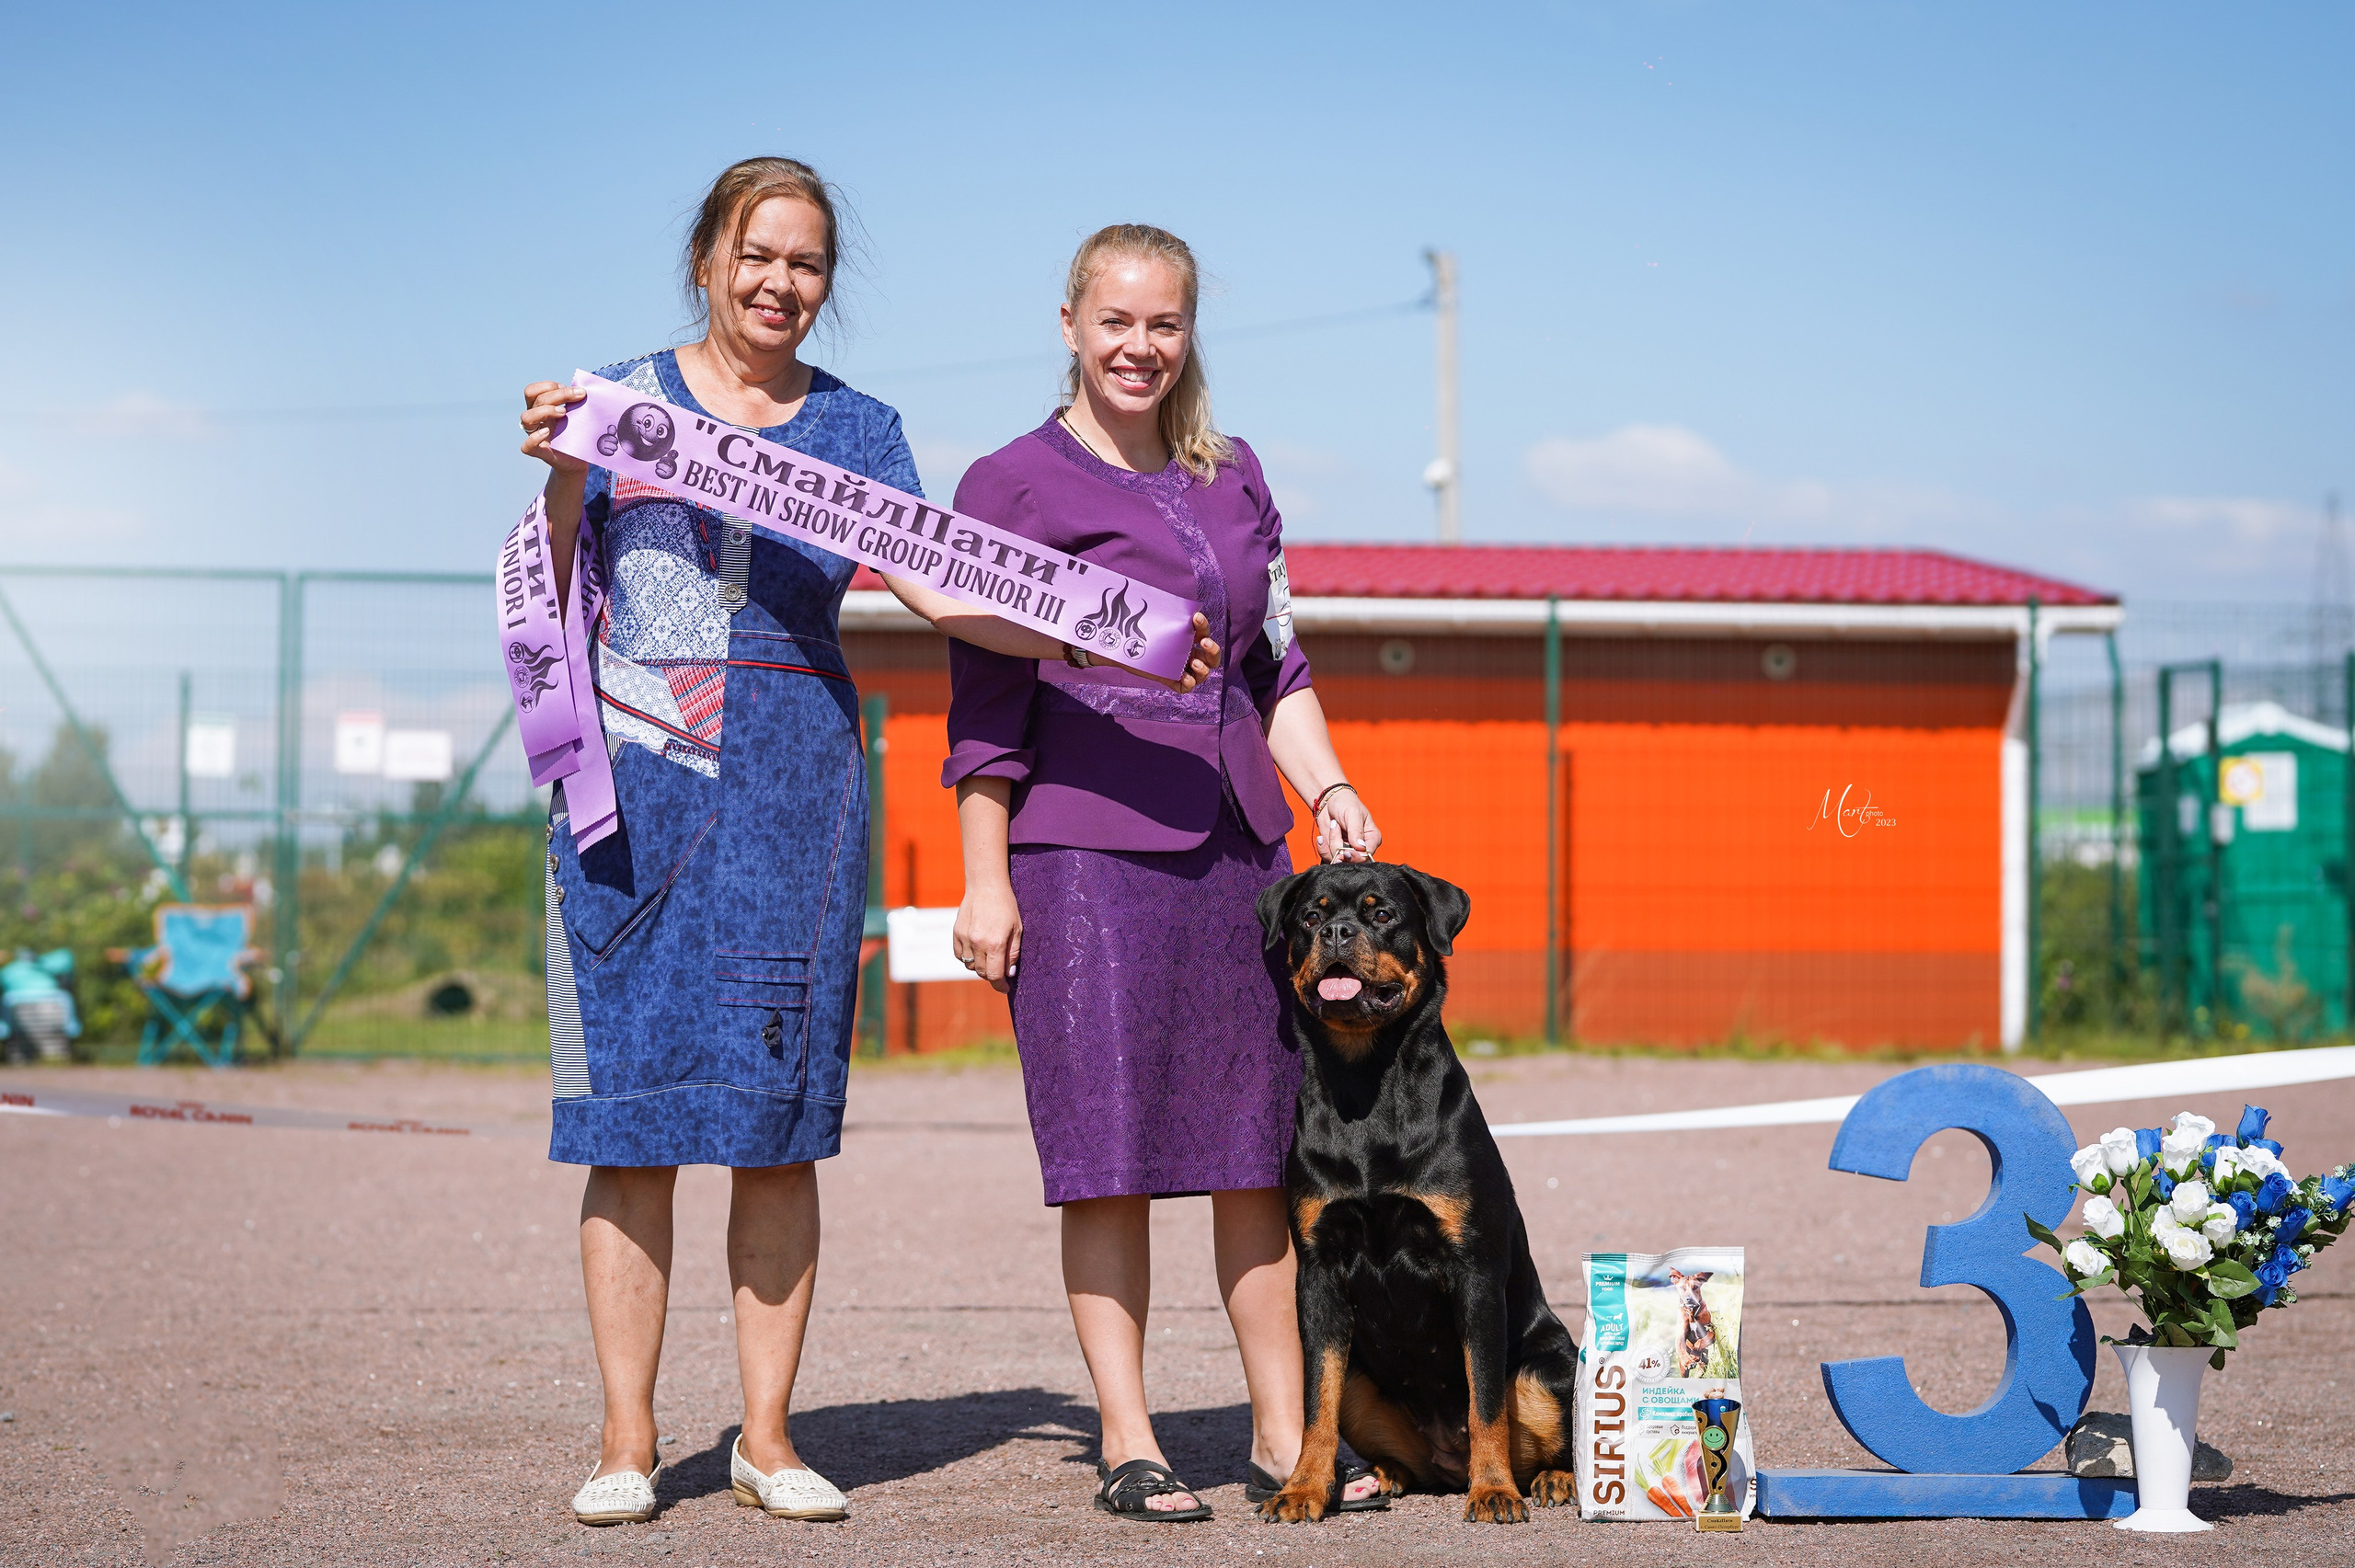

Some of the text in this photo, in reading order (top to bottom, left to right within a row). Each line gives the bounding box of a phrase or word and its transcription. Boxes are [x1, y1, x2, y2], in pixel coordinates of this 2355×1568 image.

[682, 460, 1066, 625] BEST IN SHOW GROUP JUNIOR III
[695, 418, 1088, 586] "СмайлПати"
[503, 521, 526, 630] UNIOR I
[1821, 1063, 2097, 1474] 3
[1600, 1322, 1624, 1333] ADULT
[1637, 1357, 1661, 1369] 41%
[1593, 1365, 1626, 1505] SIRIUS
[1642, 1386, 1685, 1395] ИНДЕЙКА
[1650, 1396, 1700, 1404] ОВОЩАМИ
